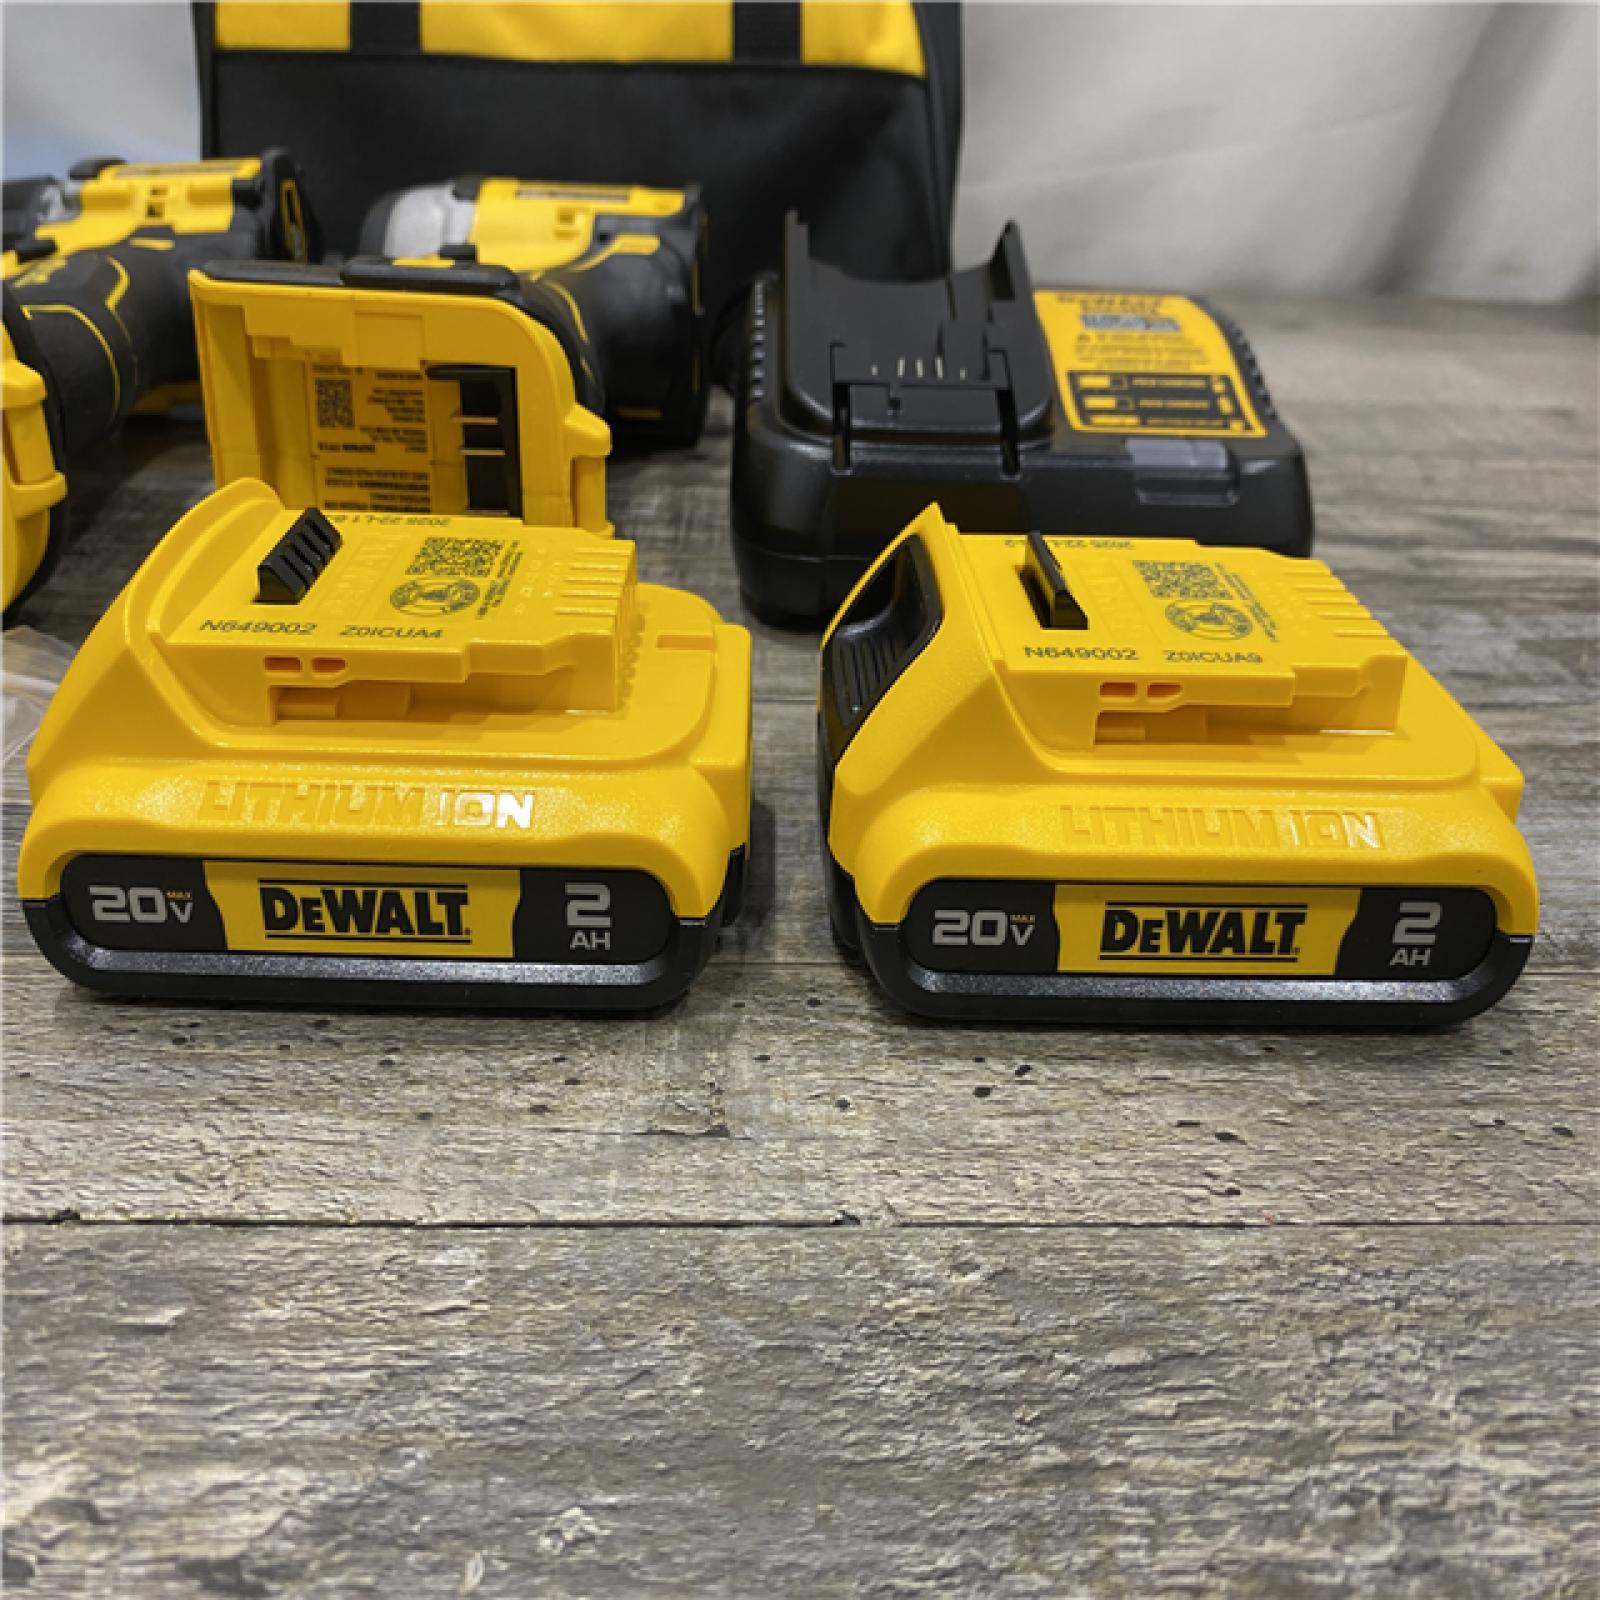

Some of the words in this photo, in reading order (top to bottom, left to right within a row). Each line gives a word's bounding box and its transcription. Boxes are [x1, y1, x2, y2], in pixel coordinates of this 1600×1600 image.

[202, 781, 426, 827] LITHIUM
[433, 788, 534, 829] ION
[1060, 806, 1281, 849] LITHIUM
[1289, 810, 1383, 849] ION
[564, 883, 612, 928] 2
[1394, 902, 1442, 944] 2
[570, 930, 612, 951] AH
[1389, 949, 1431, 967] AH
